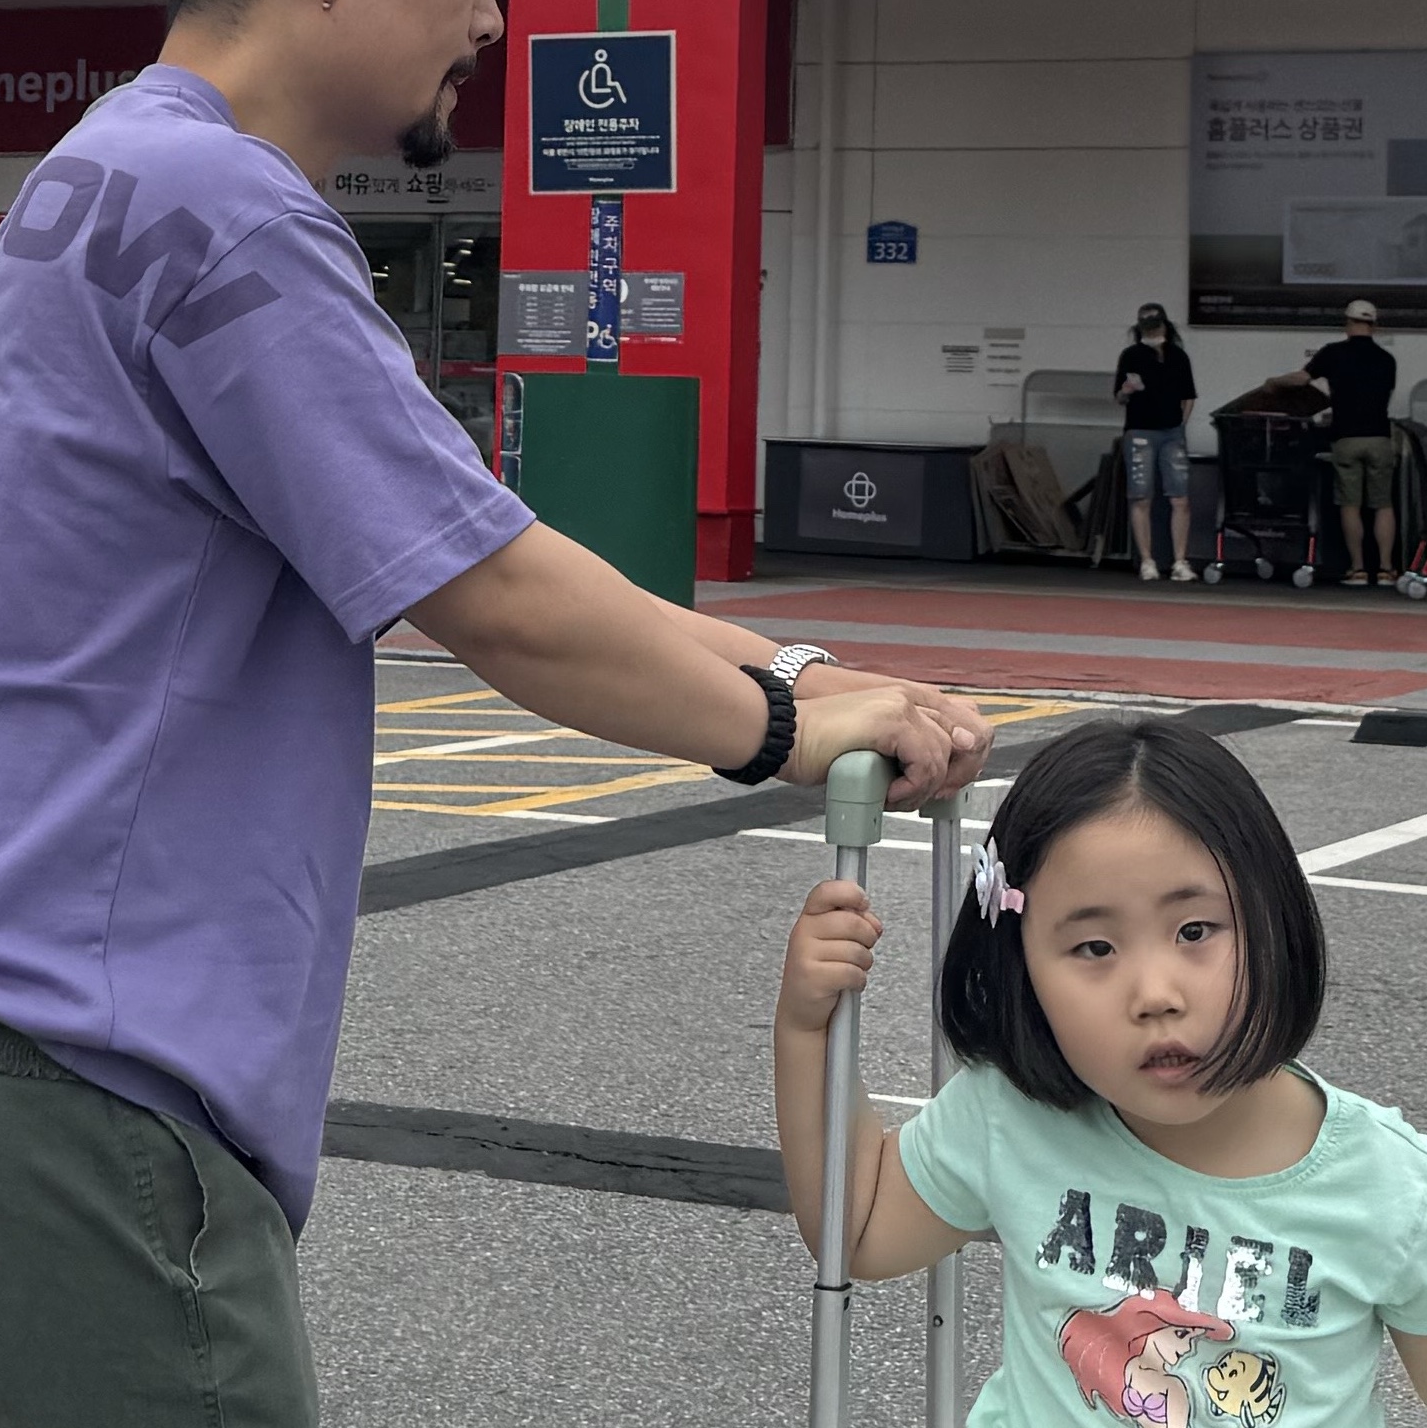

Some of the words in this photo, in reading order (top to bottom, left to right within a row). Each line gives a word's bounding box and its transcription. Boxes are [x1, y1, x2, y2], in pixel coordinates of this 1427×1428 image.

[1207, 116, 1291, 141] 홈플러스
[1299, 116, 1362, 141] 상품권
[602, 215, 620, 296] 주차구역
[874, 242, 908, 260] 332
[1035, 1189, 1323, 1328] ARIEL
